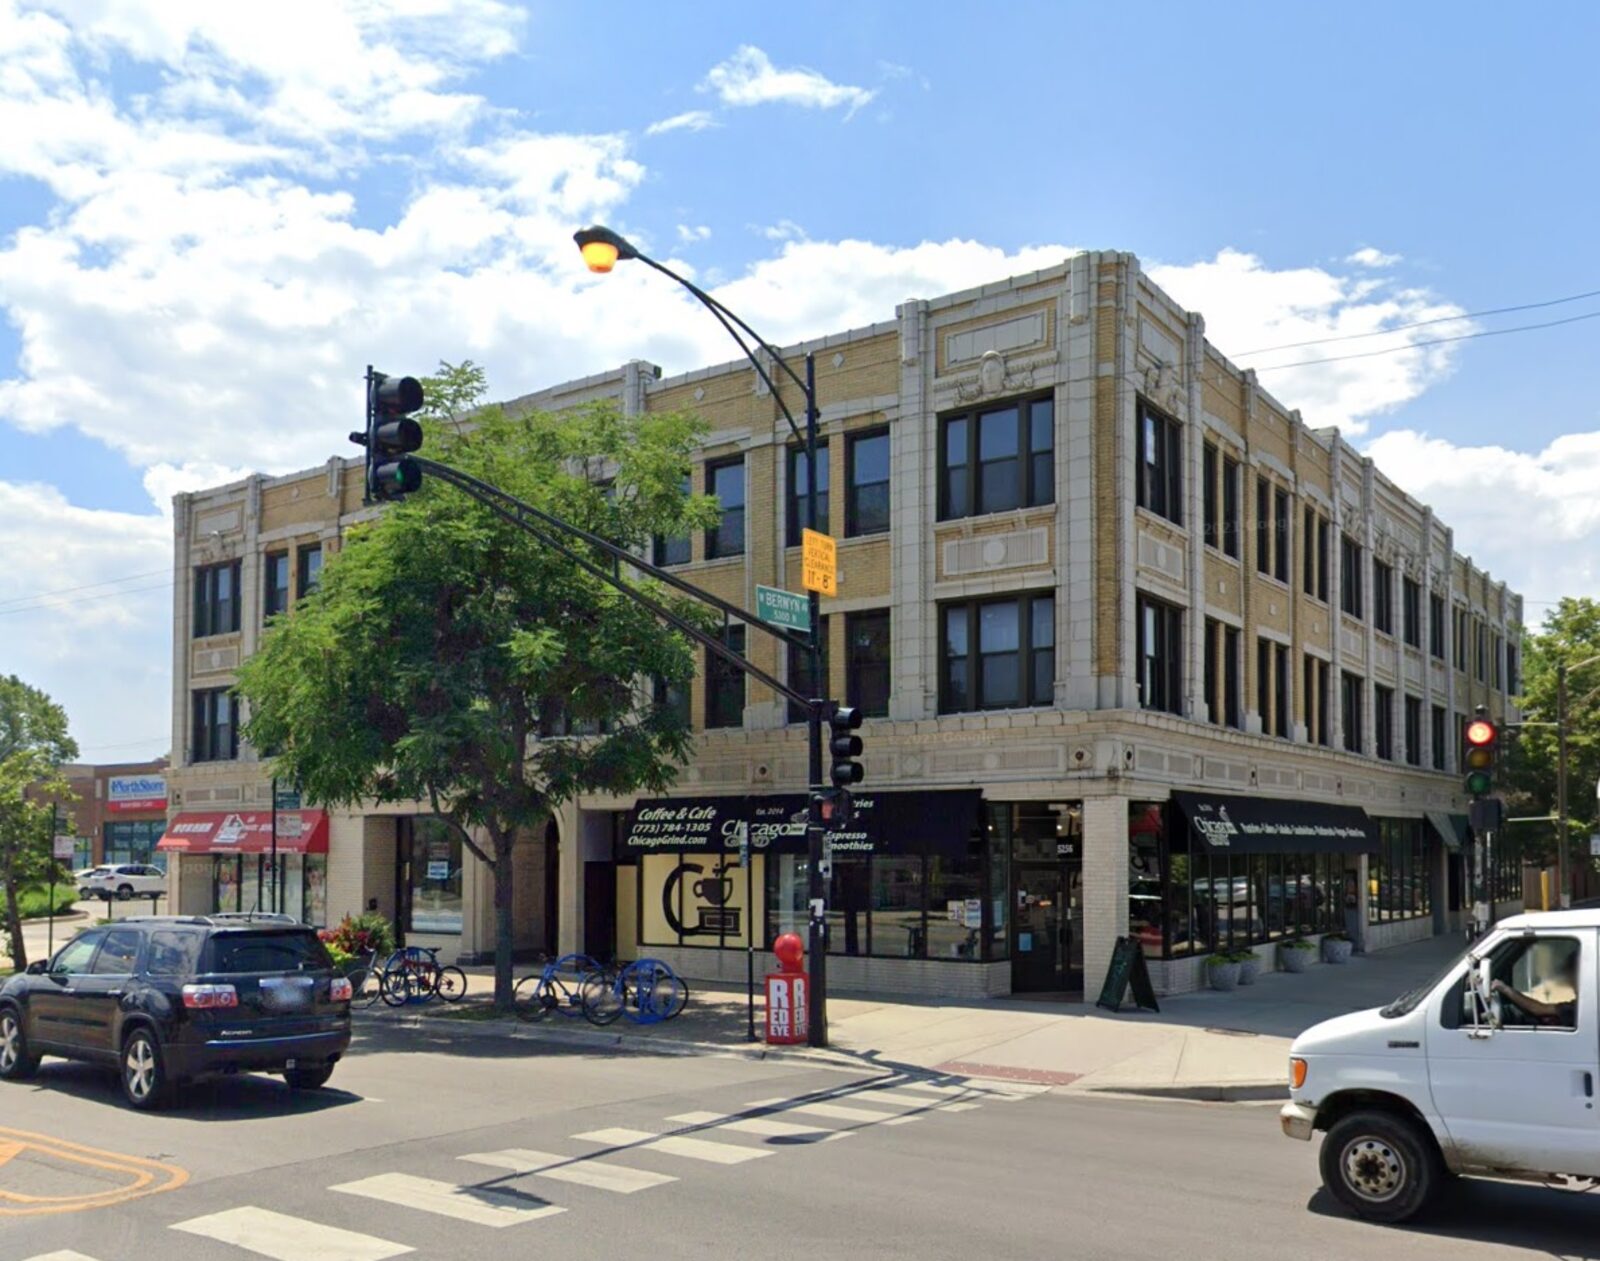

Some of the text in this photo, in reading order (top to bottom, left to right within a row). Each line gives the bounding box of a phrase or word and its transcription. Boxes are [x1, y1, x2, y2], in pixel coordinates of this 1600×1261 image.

[766, 591, 800, 612] BERWYN
[637, 806, 717, 821] Coffee & Cafe
[632, 822, 712, 834] (773) 784-1305
[627, 834, 707, 848] ChicagoGrind.com
